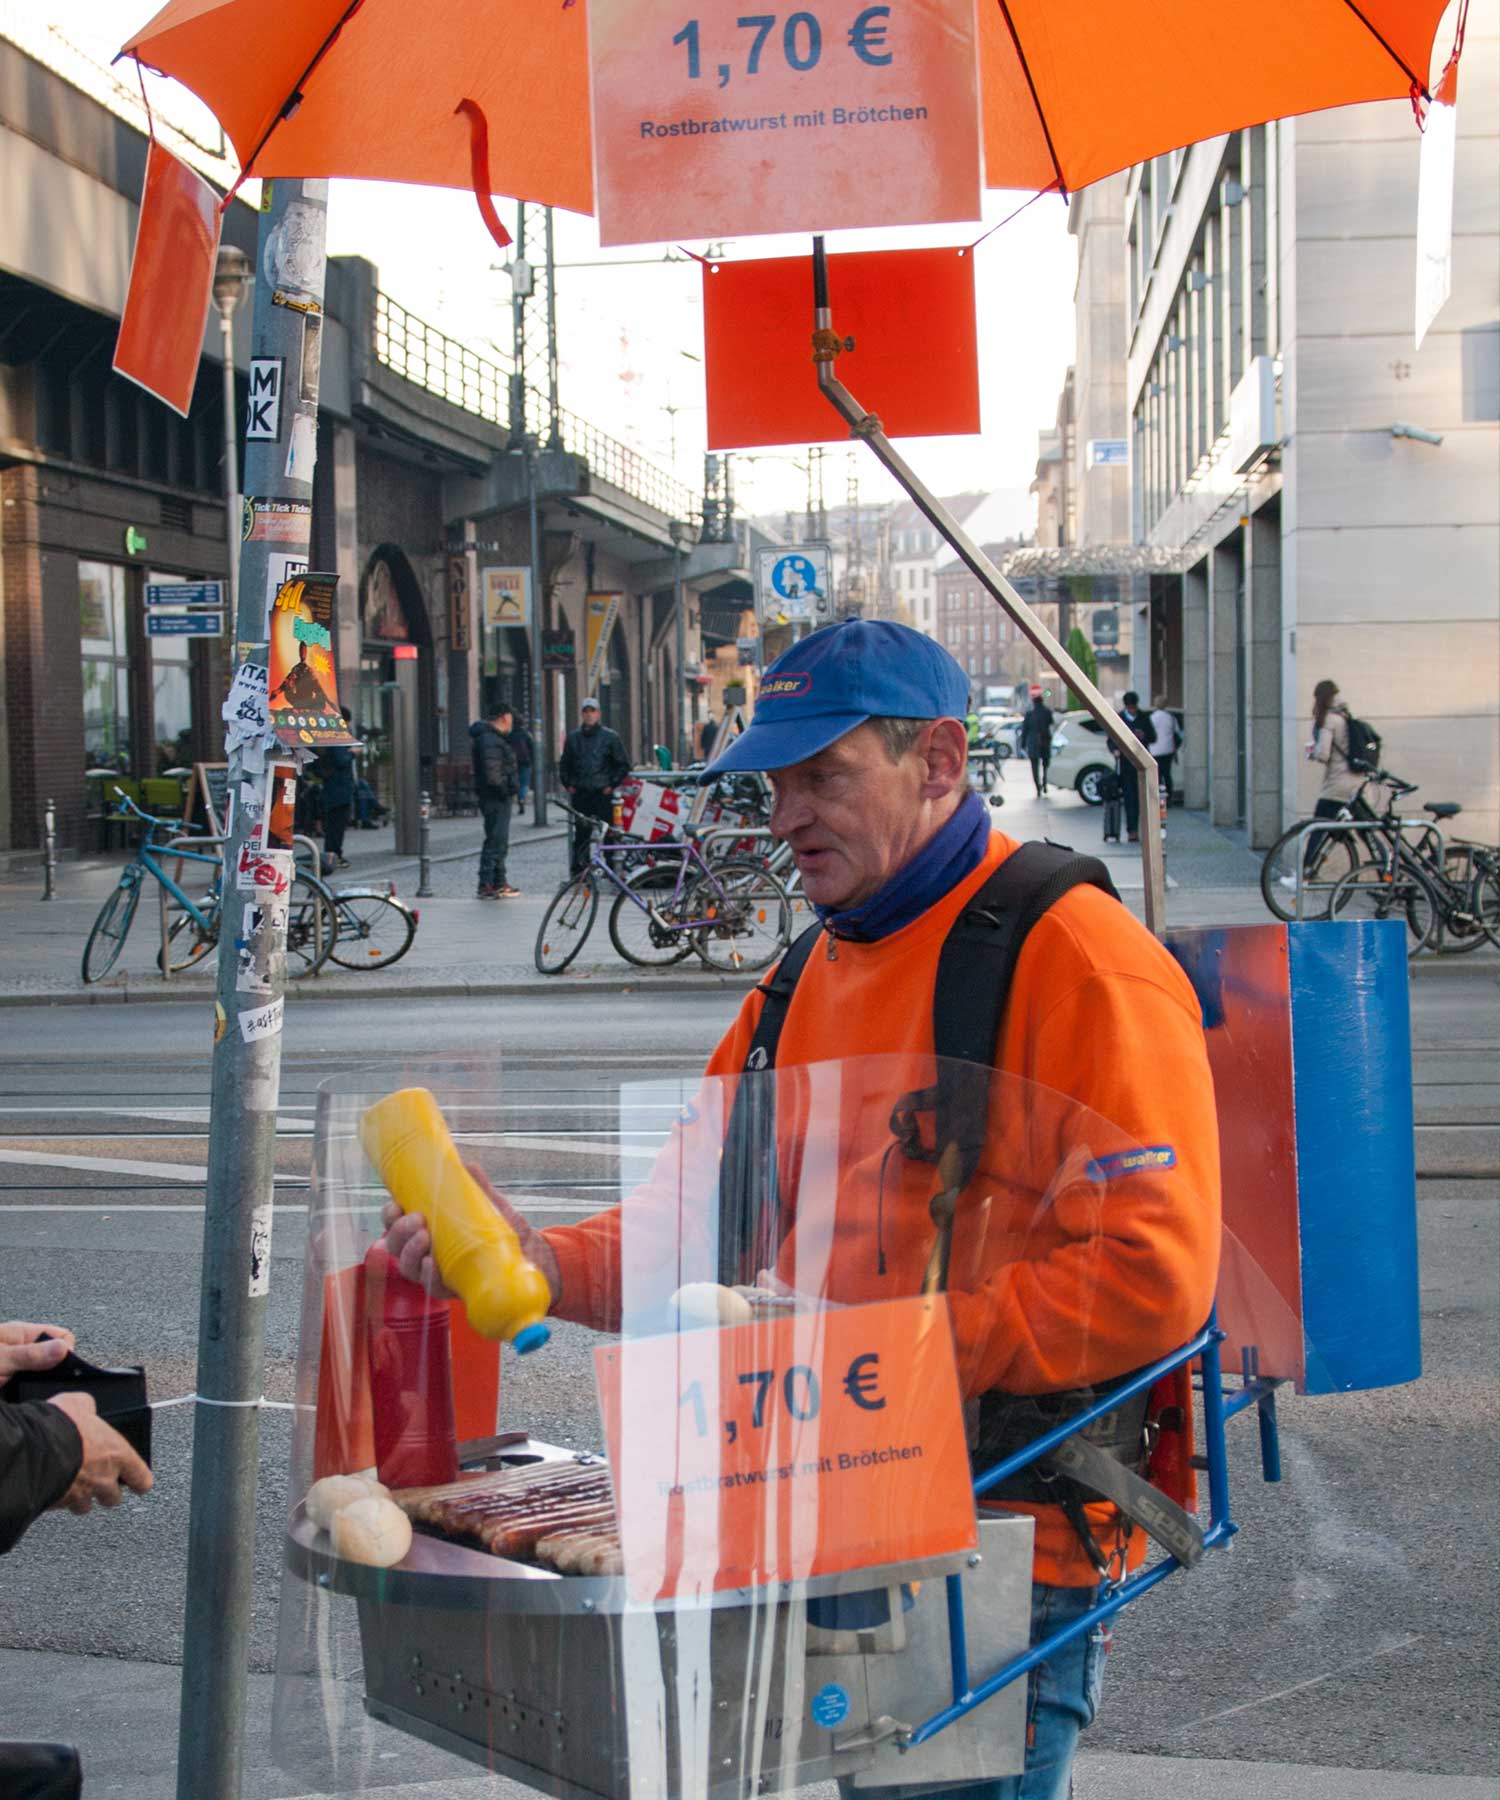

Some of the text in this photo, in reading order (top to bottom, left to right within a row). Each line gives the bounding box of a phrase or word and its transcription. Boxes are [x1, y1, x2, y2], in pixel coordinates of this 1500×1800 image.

[672, 6, 893, 89] 1,70 €
[640, 104, 928, 139] Rostbratwurst mit Brötchen
[678, 1352, 887, 1444] 1,70 €
[656, 1444, 924, 1496] Rostbratwurst mit Brötchen
